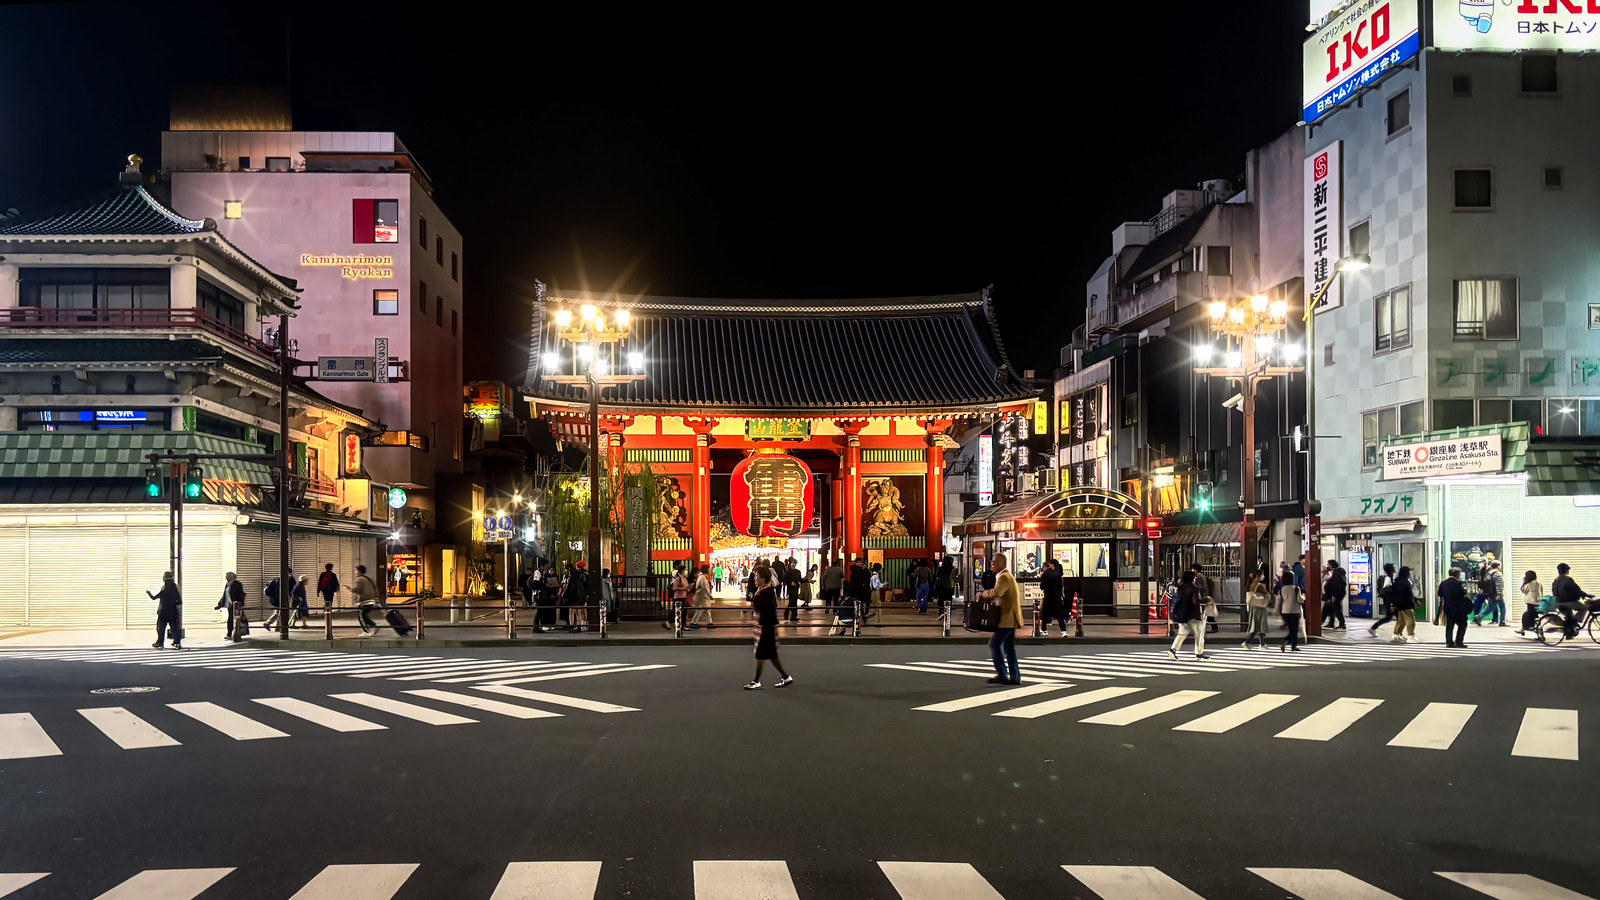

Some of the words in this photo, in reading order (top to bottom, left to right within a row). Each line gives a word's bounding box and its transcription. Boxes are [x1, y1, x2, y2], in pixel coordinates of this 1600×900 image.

[1326, 2, 1389, 83] IKO
[1317, 49, 1401, 113] 日本トムソン株式会社
[301, 254, 392, 265] Kaminarimon
[342, 267, 392, 279] Ryokan
[327, 360, 365, 370] 雷門
[377, 340, 386, 382] スクランブル式
[1439, 360, 1600, 383] アオノヤ
[1387, 449, 1411, 460] 地下鉄
[1429, 444, 1457, 455] 銀座線
[1459, 441, 1488, 452] 浅草駅
[743, 457, 808, 536] 雷門
[1360, 495, 1413, 515] アオノヤ
